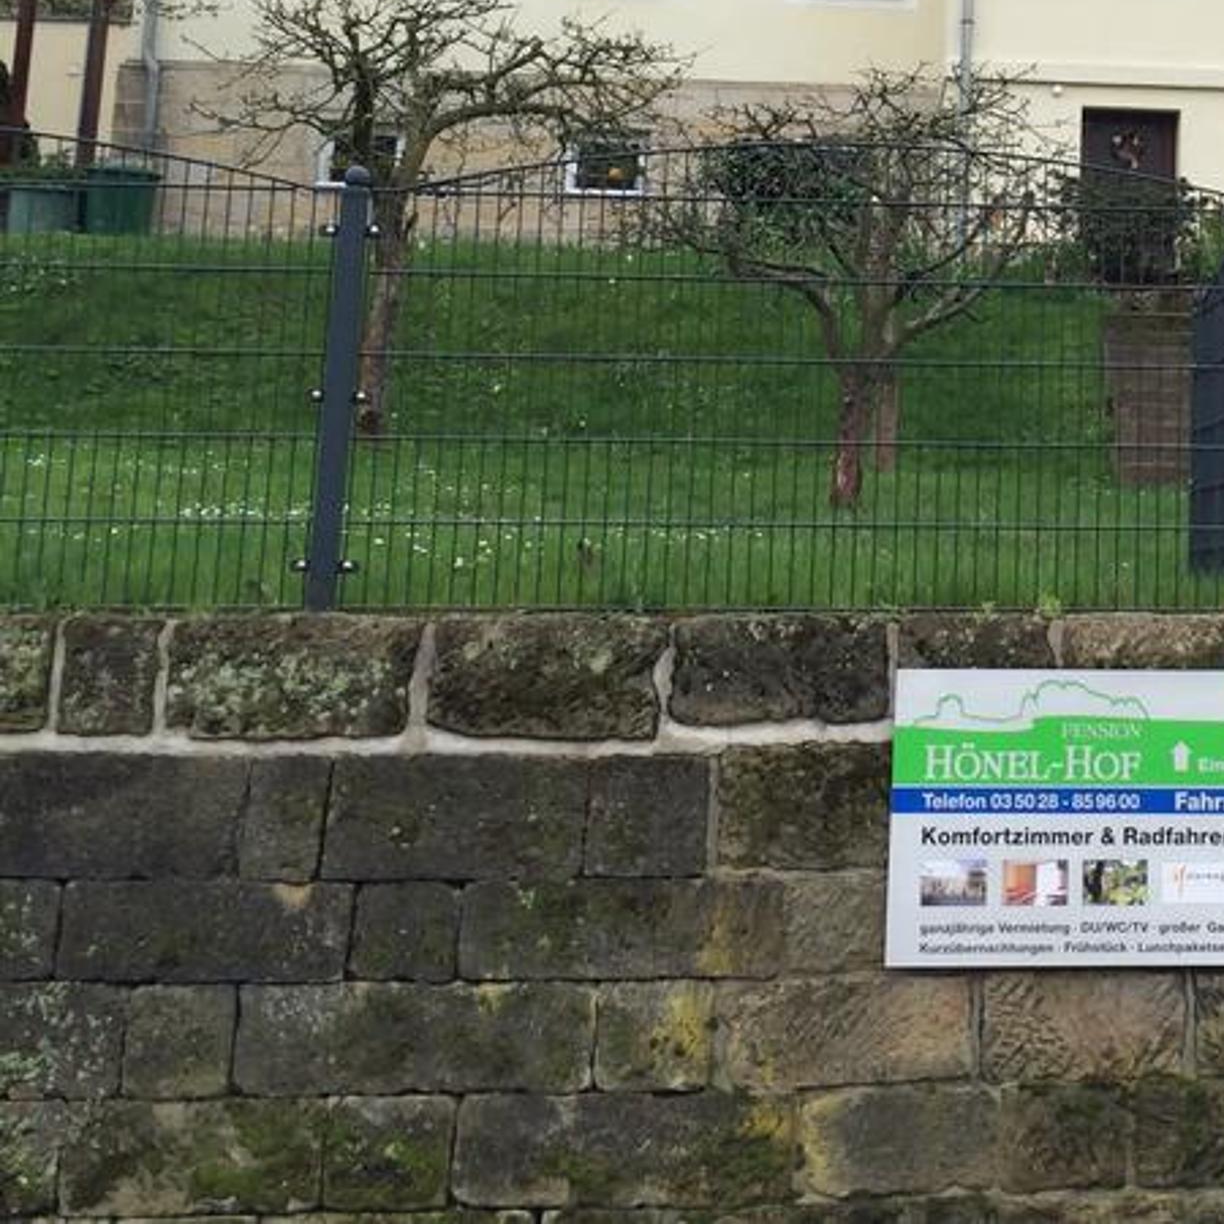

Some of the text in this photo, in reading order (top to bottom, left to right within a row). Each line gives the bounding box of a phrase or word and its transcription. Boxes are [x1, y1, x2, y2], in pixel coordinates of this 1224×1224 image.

[1062, 723, 1141, 738] PENSION
[922, 792, 987, 809] Telefon
[921, 826, 1094, 846] Komfortzimmer
[1100, 827, 1115, 845] &
[919, 923, 994, 935] ganzjährige
[998, 922, 1071, 936] Vermietung
[1080, 921, 1148, 934] DU/WC/TV
[919, 942, 1053, 955] Kurzübernachtungen
[1064, 941, 1127, 954] Frühstück
